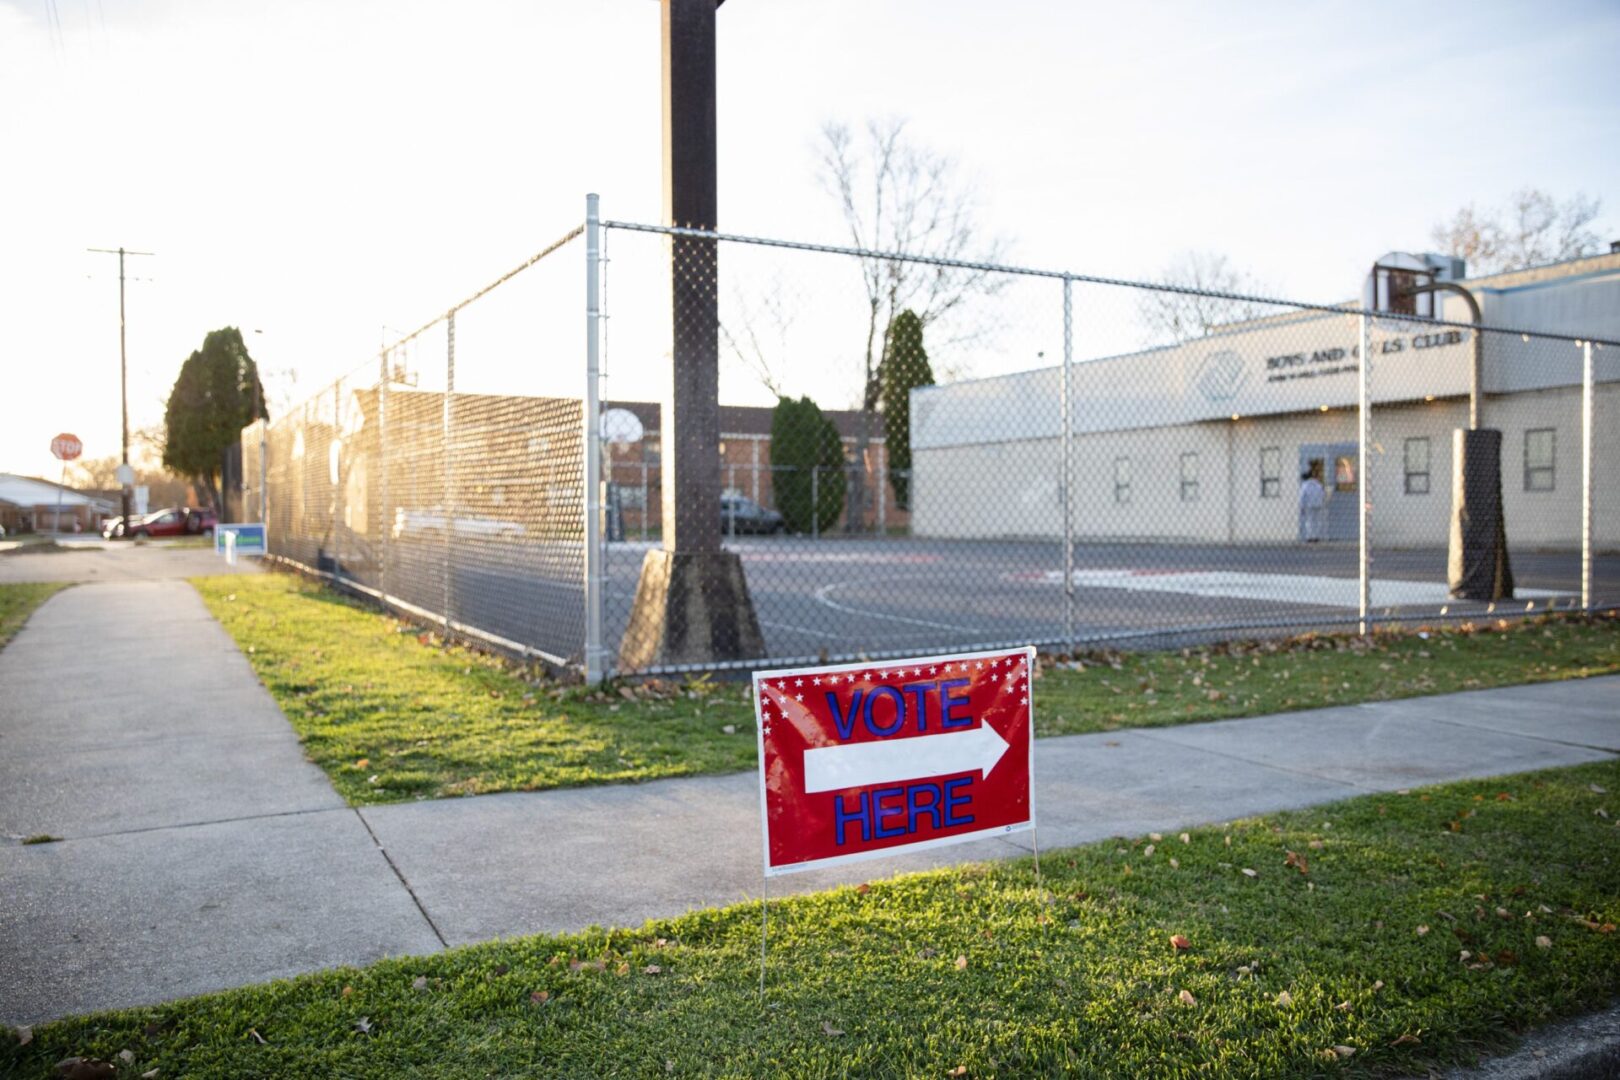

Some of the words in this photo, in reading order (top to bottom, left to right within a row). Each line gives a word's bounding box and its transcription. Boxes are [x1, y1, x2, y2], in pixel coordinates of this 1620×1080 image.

[1266, 354, 1304, 370] BOYS
[1309, 347, 1345, 363] AND
[1352, 338, 1402, 357] GLS
[1412, 330, 1462, 349] CLUB
[53, 439, 82, 453] STOP
[825, 677, 973, 740] VOTE
[834, 776, 975, 846] HERE
